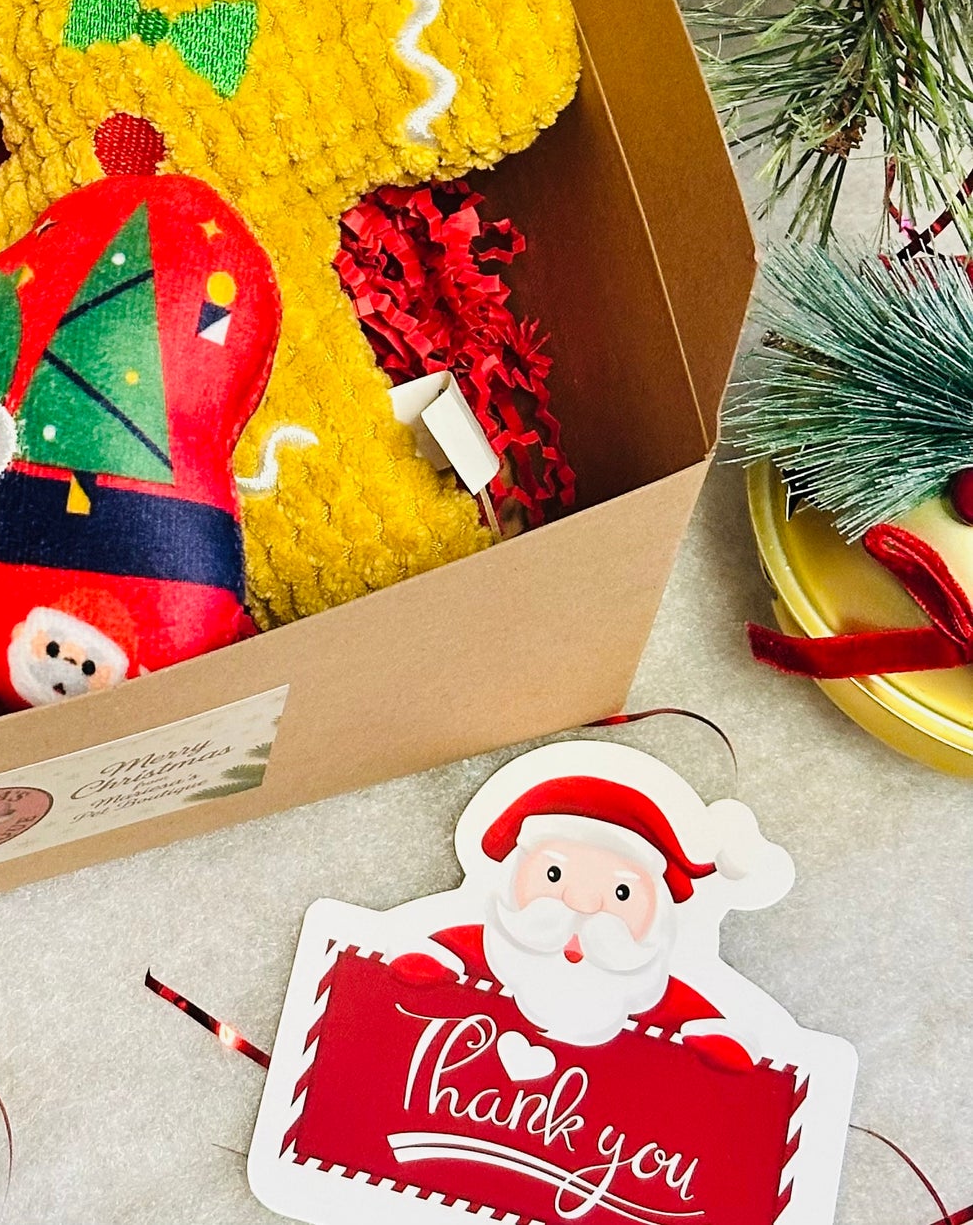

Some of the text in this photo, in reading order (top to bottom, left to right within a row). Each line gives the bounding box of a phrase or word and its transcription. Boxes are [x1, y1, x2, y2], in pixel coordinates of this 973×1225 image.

[70, 745, 234, 800] Christmas
[100, 739, 213, 778] Merry
[71, 779, 208, 823] Pet Boutique
[394, 1002, 702, 1220] Thank you
